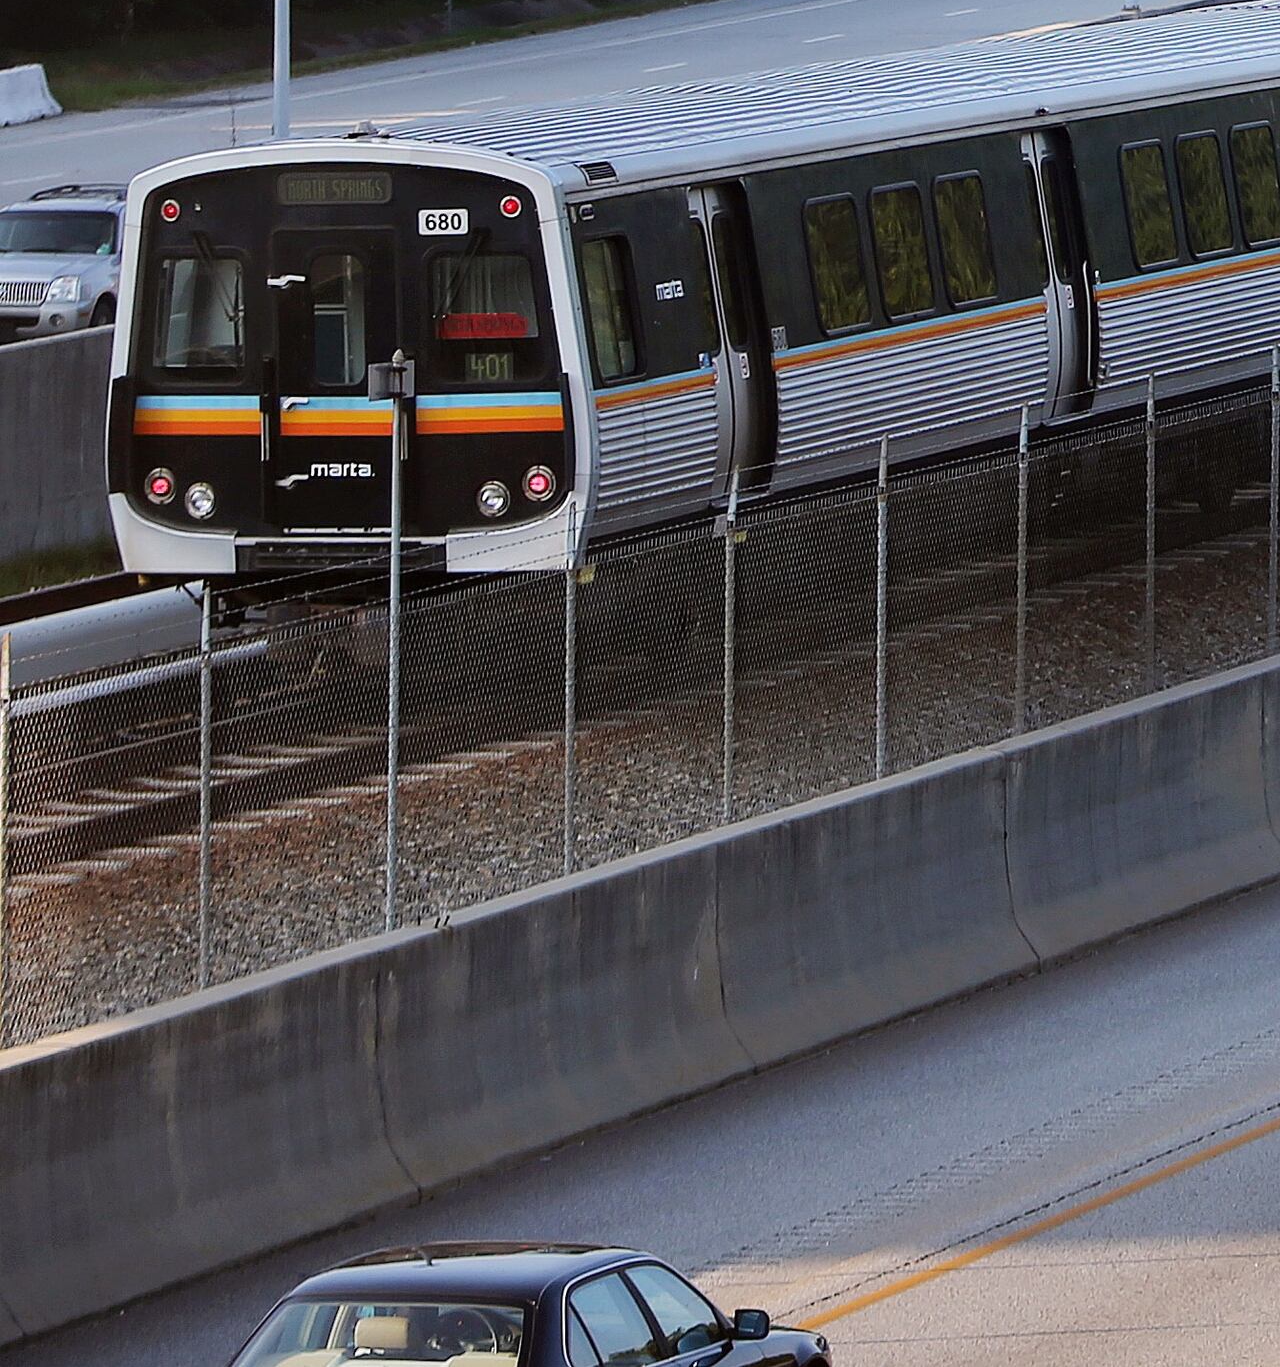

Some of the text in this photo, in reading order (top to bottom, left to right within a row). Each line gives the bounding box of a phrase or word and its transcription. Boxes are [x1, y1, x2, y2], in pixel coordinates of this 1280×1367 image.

[288, 179, 383, 200] NORTH SPRINGS
[425, 214, 462, 231] 680
[471, 354, 509, 380] 401
